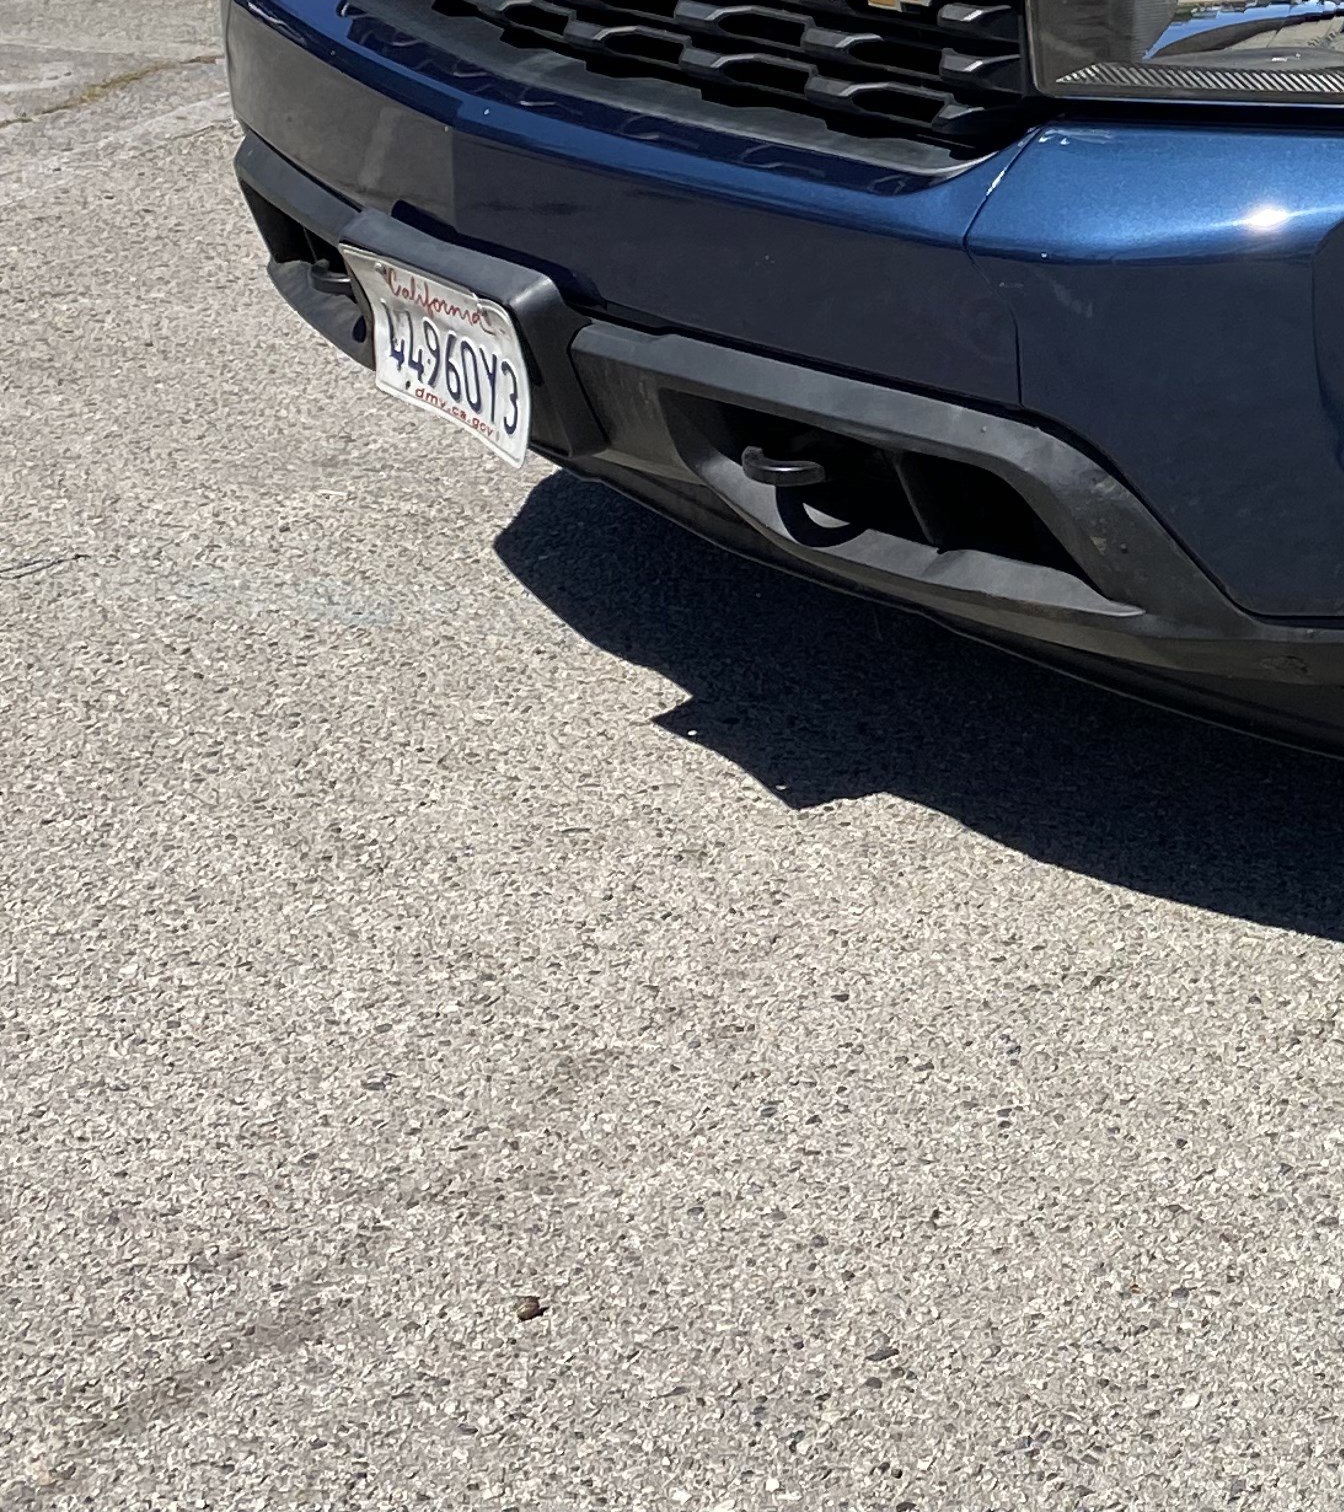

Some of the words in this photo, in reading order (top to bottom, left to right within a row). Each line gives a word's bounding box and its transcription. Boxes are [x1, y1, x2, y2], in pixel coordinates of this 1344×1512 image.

[385, 267, 486, 327] California
[379, 299, 519, 436] 44960Y3
[414, 386, 495, 438] dmv.ca.gov
